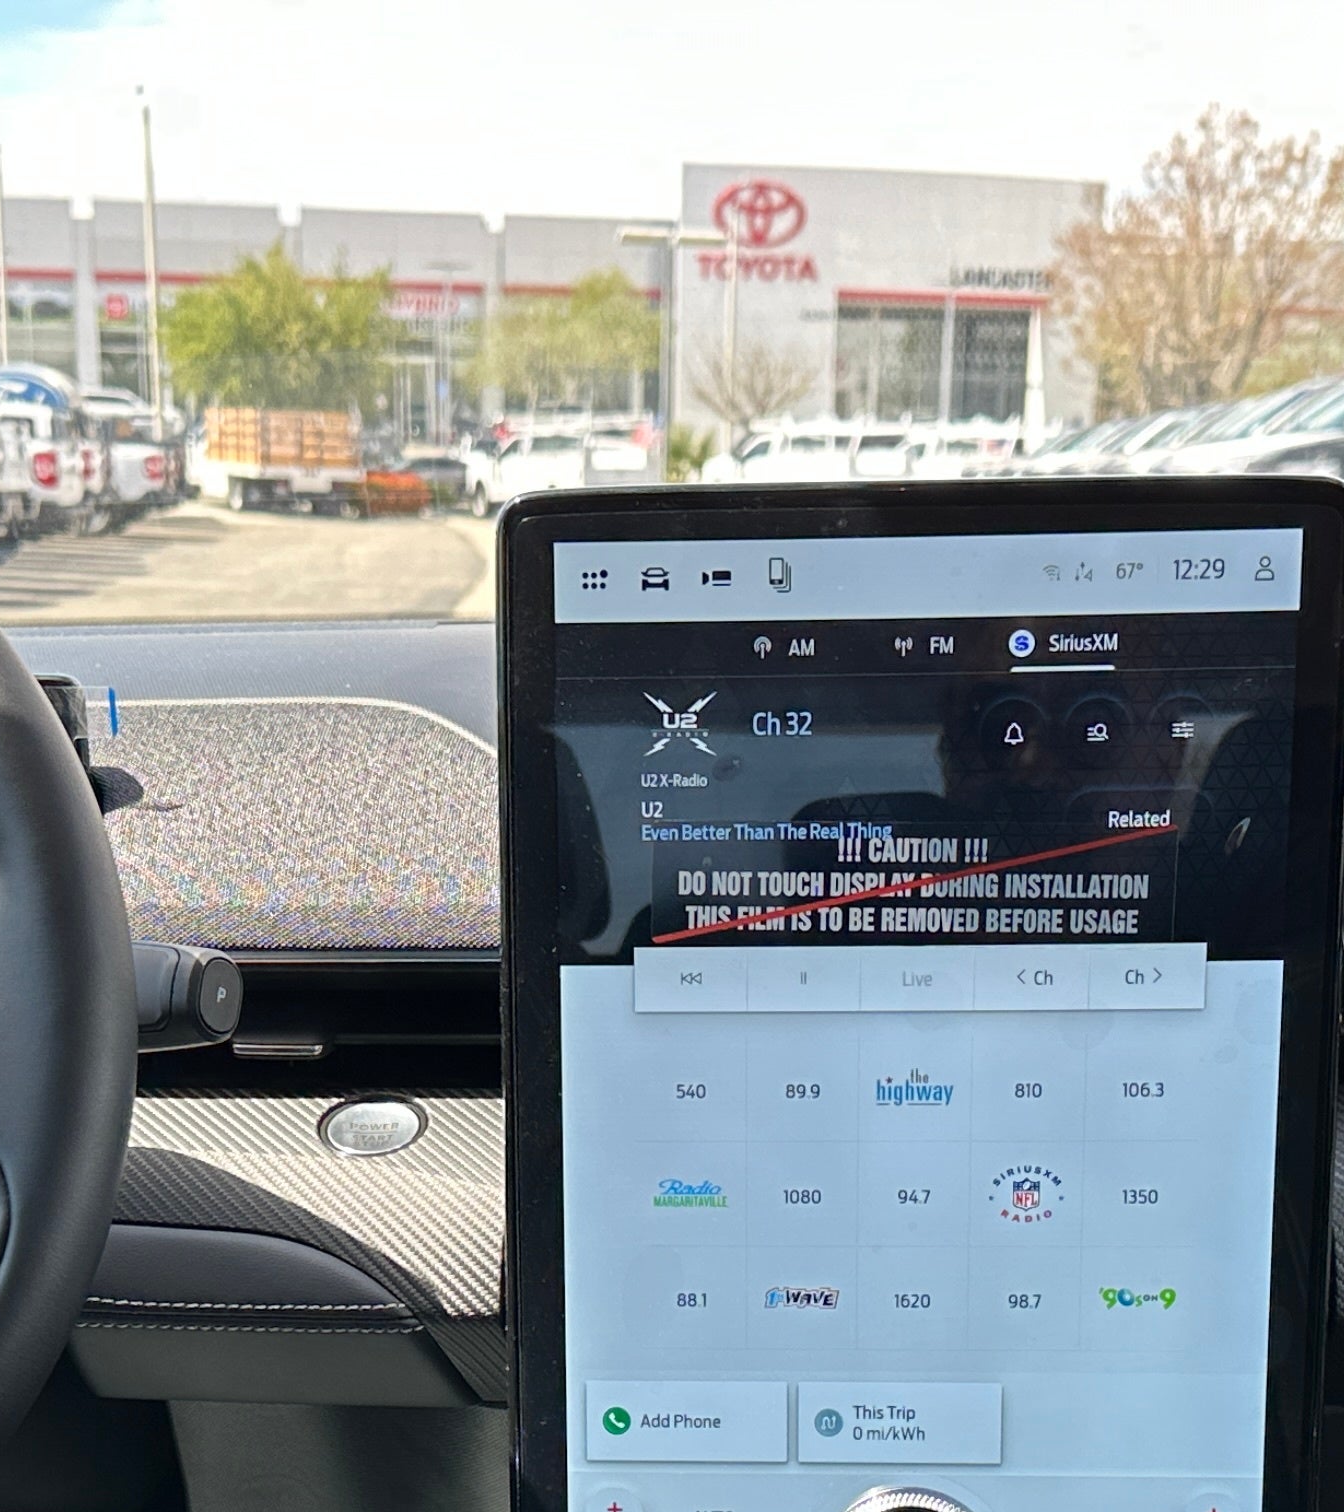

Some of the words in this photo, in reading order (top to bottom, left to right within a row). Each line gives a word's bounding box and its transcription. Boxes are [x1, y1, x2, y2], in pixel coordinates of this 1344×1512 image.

[698, 253, 818, 282] TOYOTA
[1173, 559, 1226, 580] 12:29
[788, 639, 815, 657] AM
[930, 637, 954, 655] FM
[1049, 633, 1119, 652] SiriusXM
[663, 713, 698, 729] U2
[753, 712, 780, 736] Ch
[786, 712, 813, 736] 32
[641, 774, 657, 787] U2
[659, 773, 708, 788] X-Radio
[641, 801, 663, 818] U2
[1108, 809, 1171, 828] Related
[641, 824, 679, 841] Even
[682, 824, 732, 841] Better
[734, 823, 775, 840] Than
[777, 822, 807, 840] The
[810, 822, 844, 839] Real
[847, 821, 892, 841] Thing
[868, 838, 958, 863] CAUTION
[678, 870, 706, 896] DO
[712, 871, 753, 896] NOT
[758, 872, 824, 897] TOUCH
[830, 872, 915, 898] DISPLAY
[920, 873, 999, 899] DURING
[1004, 874, 1149, 899] INSTALLATION
[685, 905, 731, 930] THIS
[737, 906, 785, 931] FILM
[792, 907, 812, 932] IS
[818, 907, 844, 932] TO
[848, 907, 875, 932] BE
[881, 907, 980, 933] REMOVED
[986, 908, 1063, 933] BEFORE
[1070, 908, 1139, 934] USAGE
[902, 970, 933, 987] Live
[1034, 970, 1053, 986] Ch
[1125, 969, 1144, 985] Ch
[910, 1068, 929, 1084] the
[675, 1083, 707, 1099] 540
[786, 1083, 821, 1099] 89.9
[876, 1078, 953, 1106] highway
[1014, 1082, 1043, 1099] 810
[1122, 1082, 1165, 1098] 106.3
[992, 1164, 1062, 1188] SIRIUSXM
[658, 1178, 722, 1196] Radio
[783, 1189, 822, 1205] 1080
[897, 1189, 931, 1205] 94.7
[1015, 1191, 1038, 1208] NFL
[1122, 1189, 1159, 1205] 1350
[1000, 1208, 1053, 1223] RADIO
[676, 1292, 707, 1308] 88.1
[894, 1293, 931, 1309] 1620
[1008, 1293, 1042, 1309] 98.7
[1159, 1287, 1177, 1310] 9
[640, 1413, 671, 1429] Add
[674, 1414, 722, 1429] Phone
[852, 1405, 884, 1420] This
[887, 1406, 916, 1422] Trip
[852, 1427, 863, 1441] 0
[866, 1427, 926, 1442] mi/kWh
